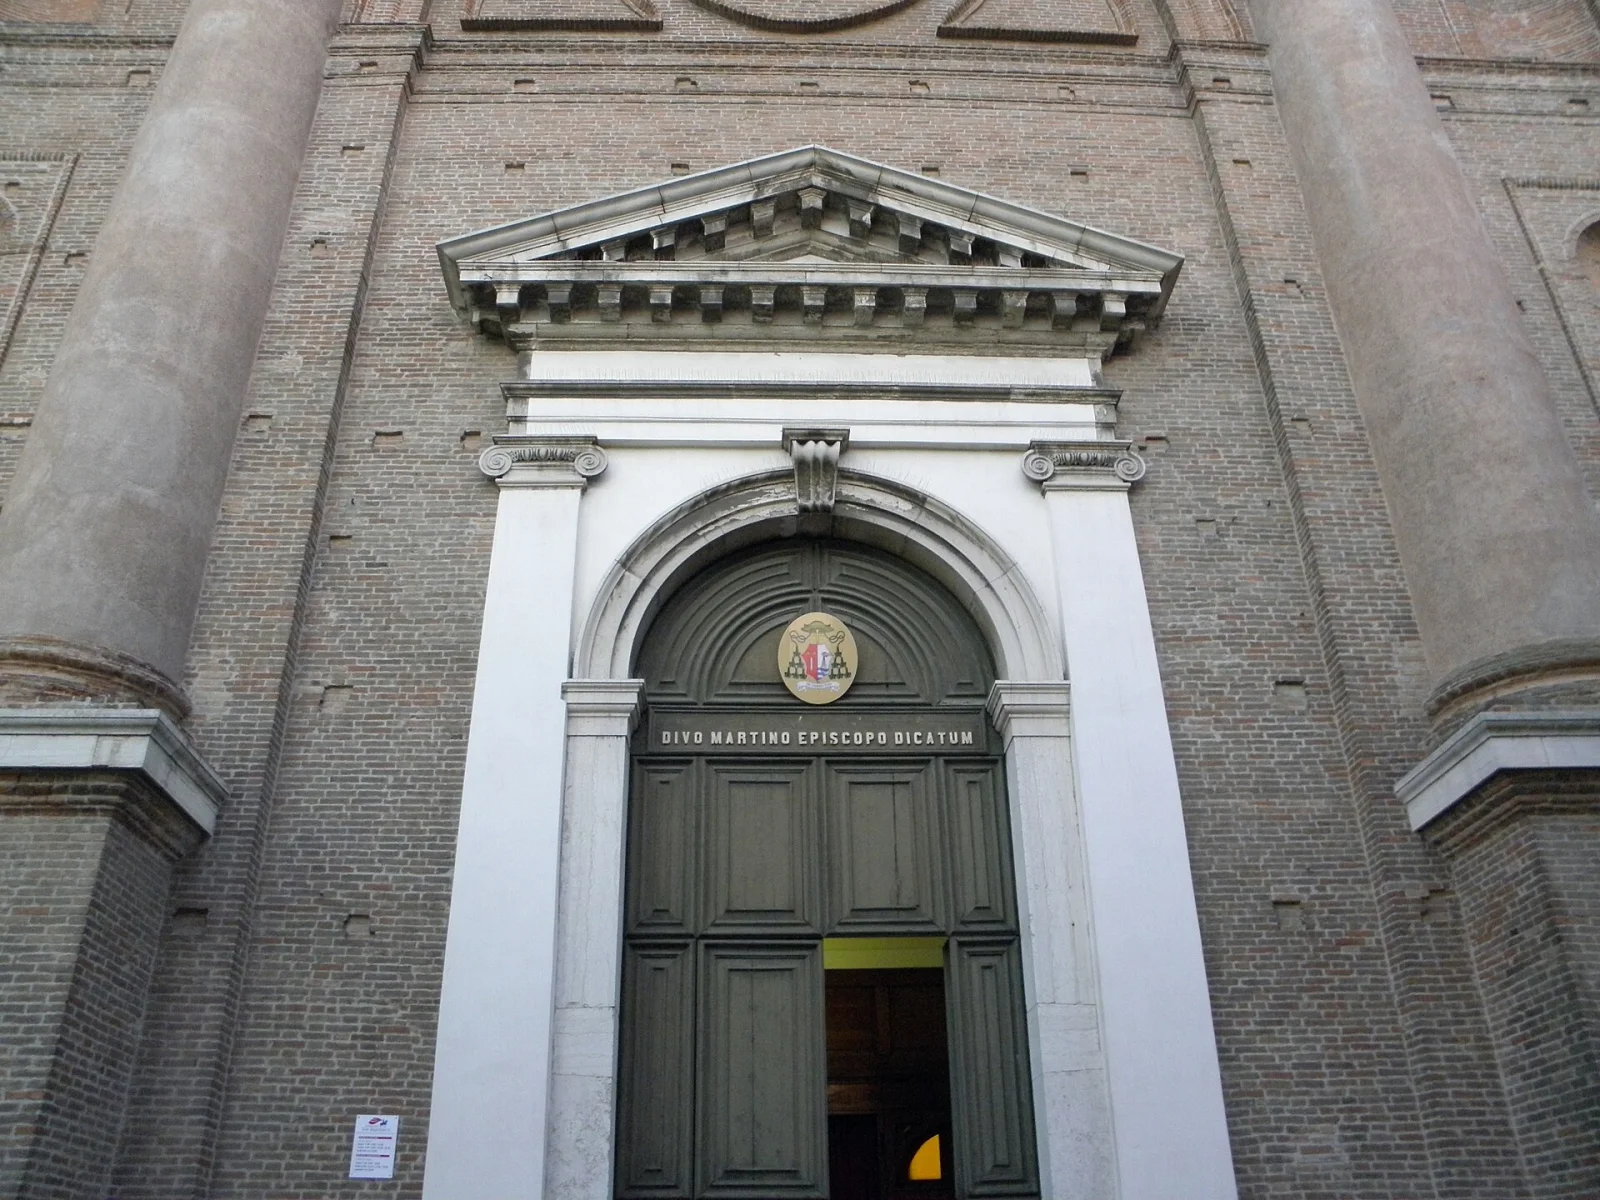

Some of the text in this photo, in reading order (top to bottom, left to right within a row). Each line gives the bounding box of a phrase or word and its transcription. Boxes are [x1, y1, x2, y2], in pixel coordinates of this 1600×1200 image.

[662, 731, 974, 745] DIVO MARTINO EPISCOPO DICATUM
